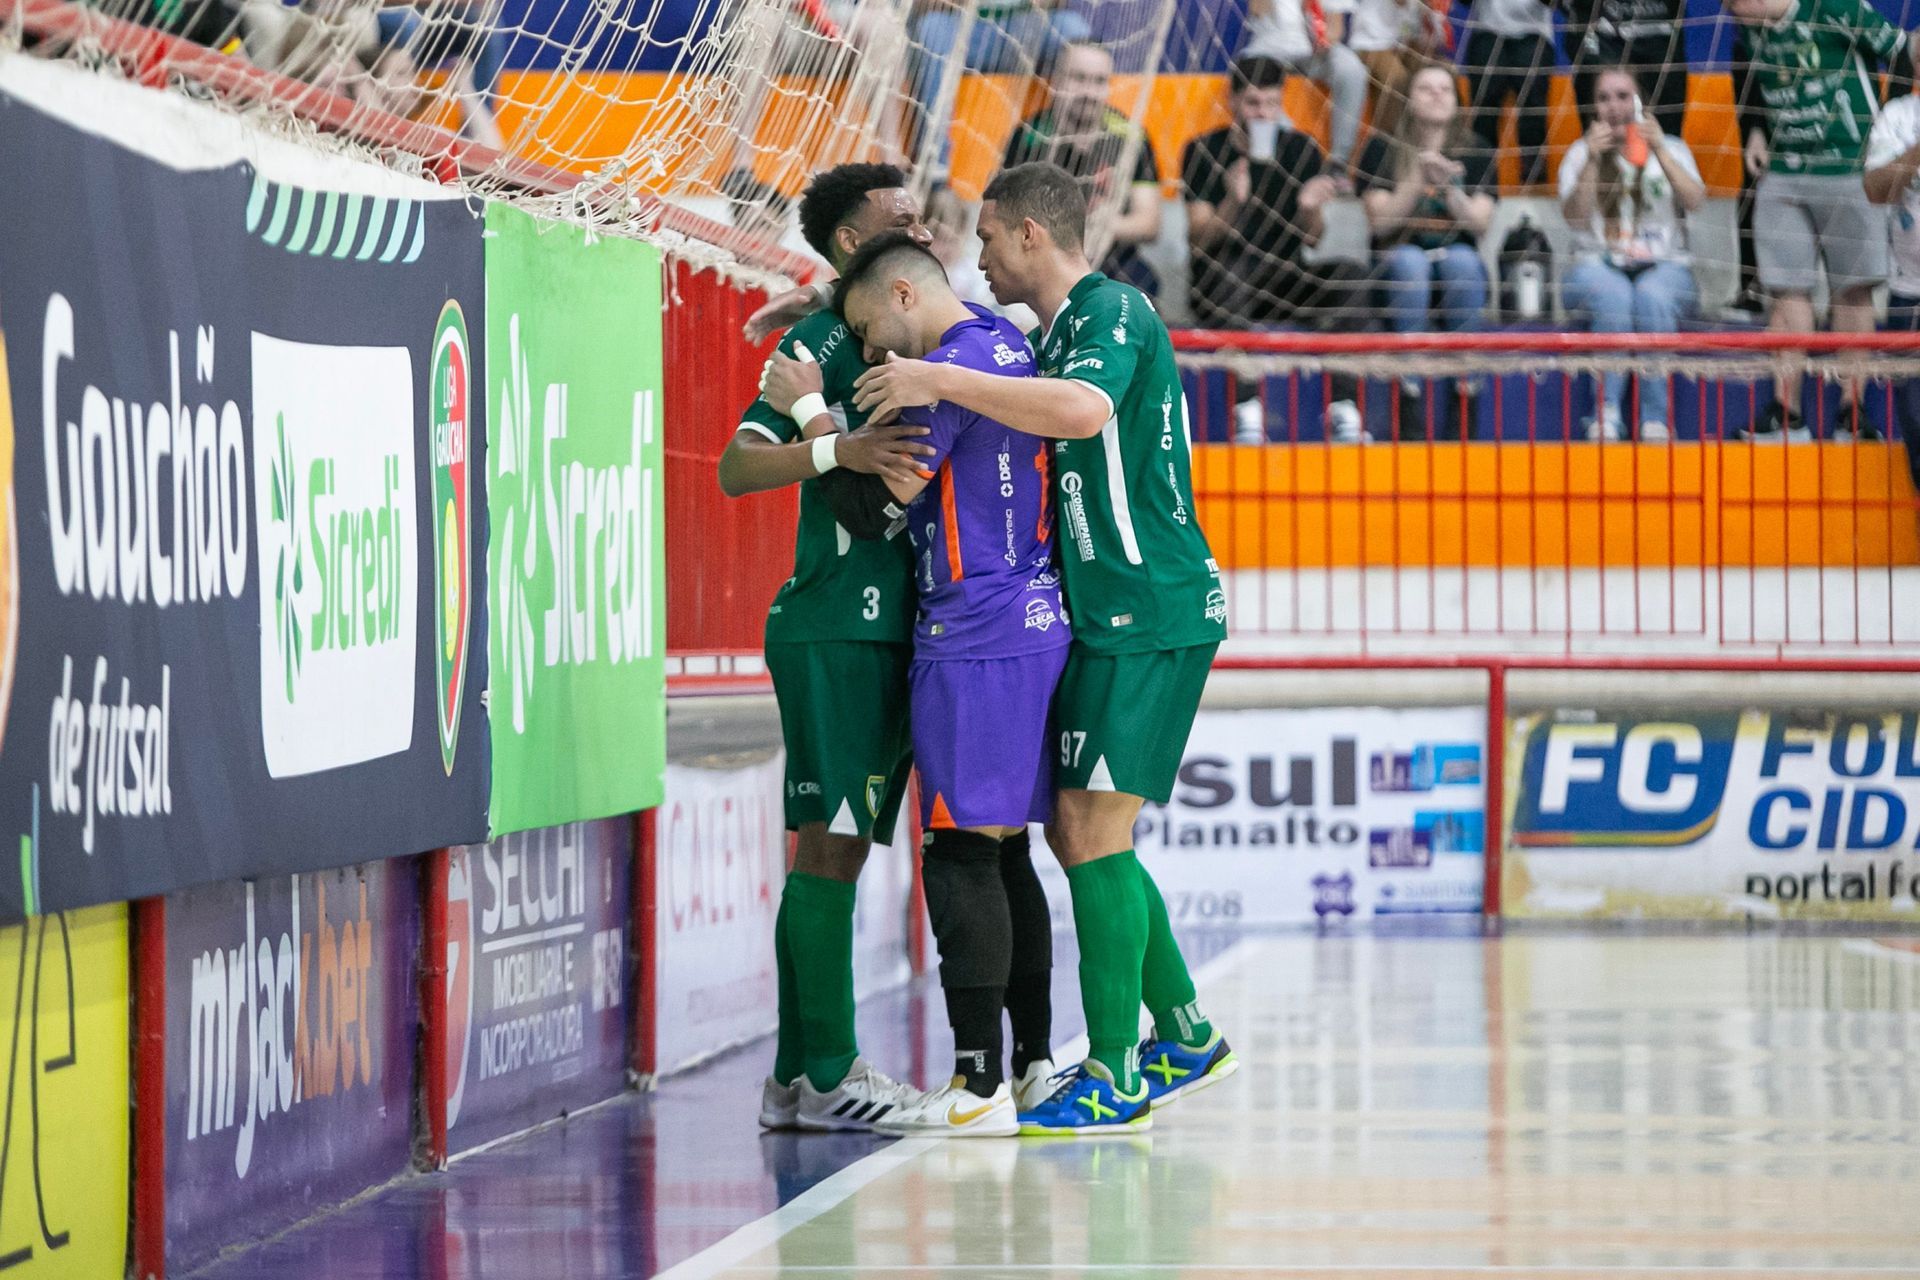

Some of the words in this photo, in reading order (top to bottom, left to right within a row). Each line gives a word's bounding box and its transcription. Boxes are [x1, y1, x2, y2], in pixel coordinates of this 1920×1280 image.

[42, 292, 248, 607] Gauchão
[998, 452, 1012, 481] DPS
[310, 454, 401, 652] Sicredi
[544, 382, 653, 667] Sicredi
[1071, 491, 1096, 561] CONCREPASSOS
[862, 586, 880, 620] 3
[48, 655, 81, 815] de
[82, 655, 171, 855] futsal
[1061, 731, 1087, 768] 97
[1145, 738, 1357, 809] sul
[1539, 722, 1703, 815] FC
[1133, 816, 1359, 846] Planalto
[1748, 786, 1920, 849] CID
[1746, 862, 1874, 916] portal
